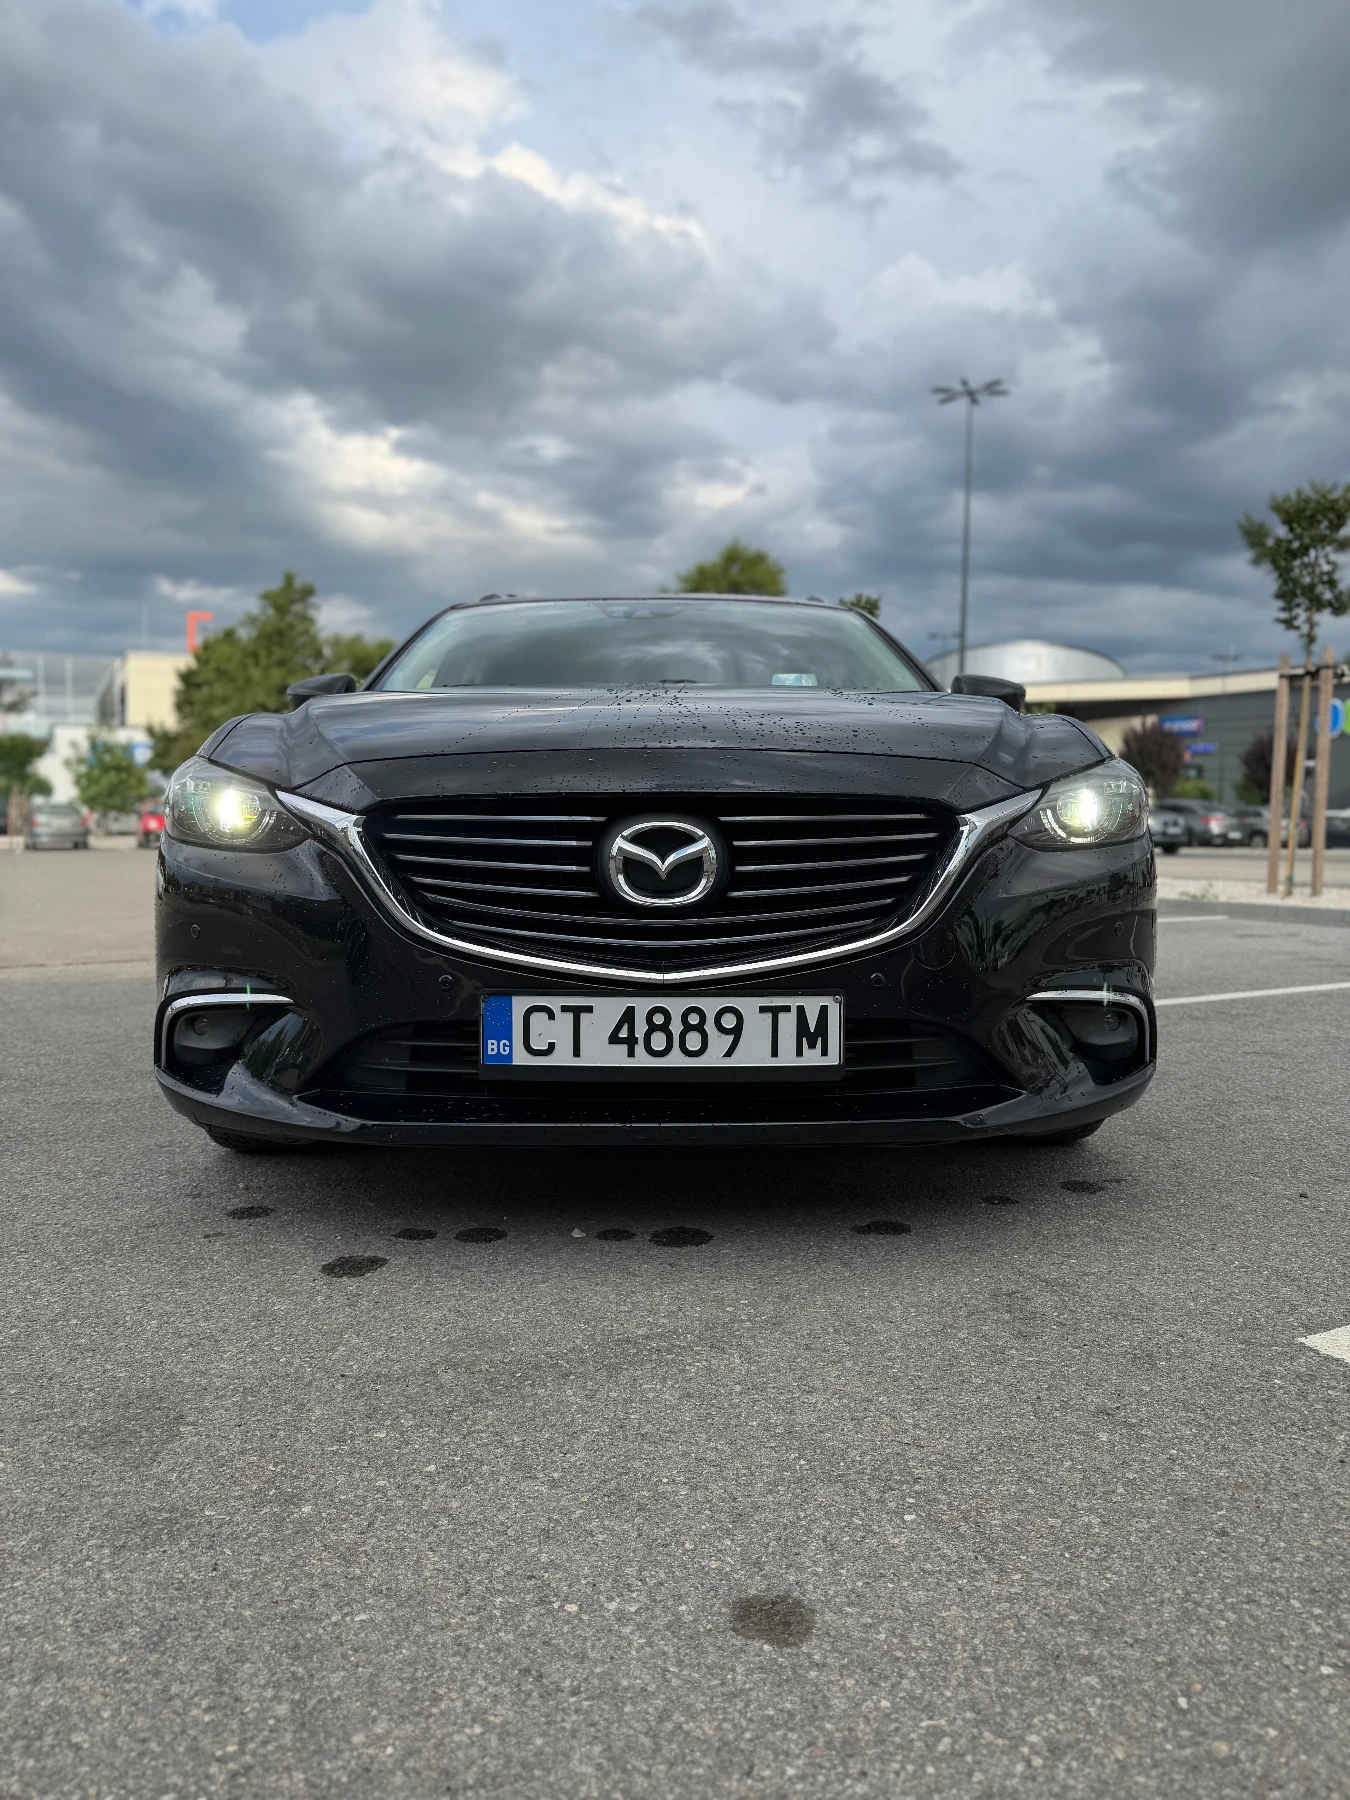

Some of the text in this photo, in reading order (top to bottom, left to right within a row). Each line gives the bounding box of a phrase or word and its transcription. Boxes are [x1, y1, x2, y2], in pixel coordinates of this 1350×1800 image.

[487, 1039, 510, 1055] BG
[522, 1004, 829, 1058] CT 4889 TM
